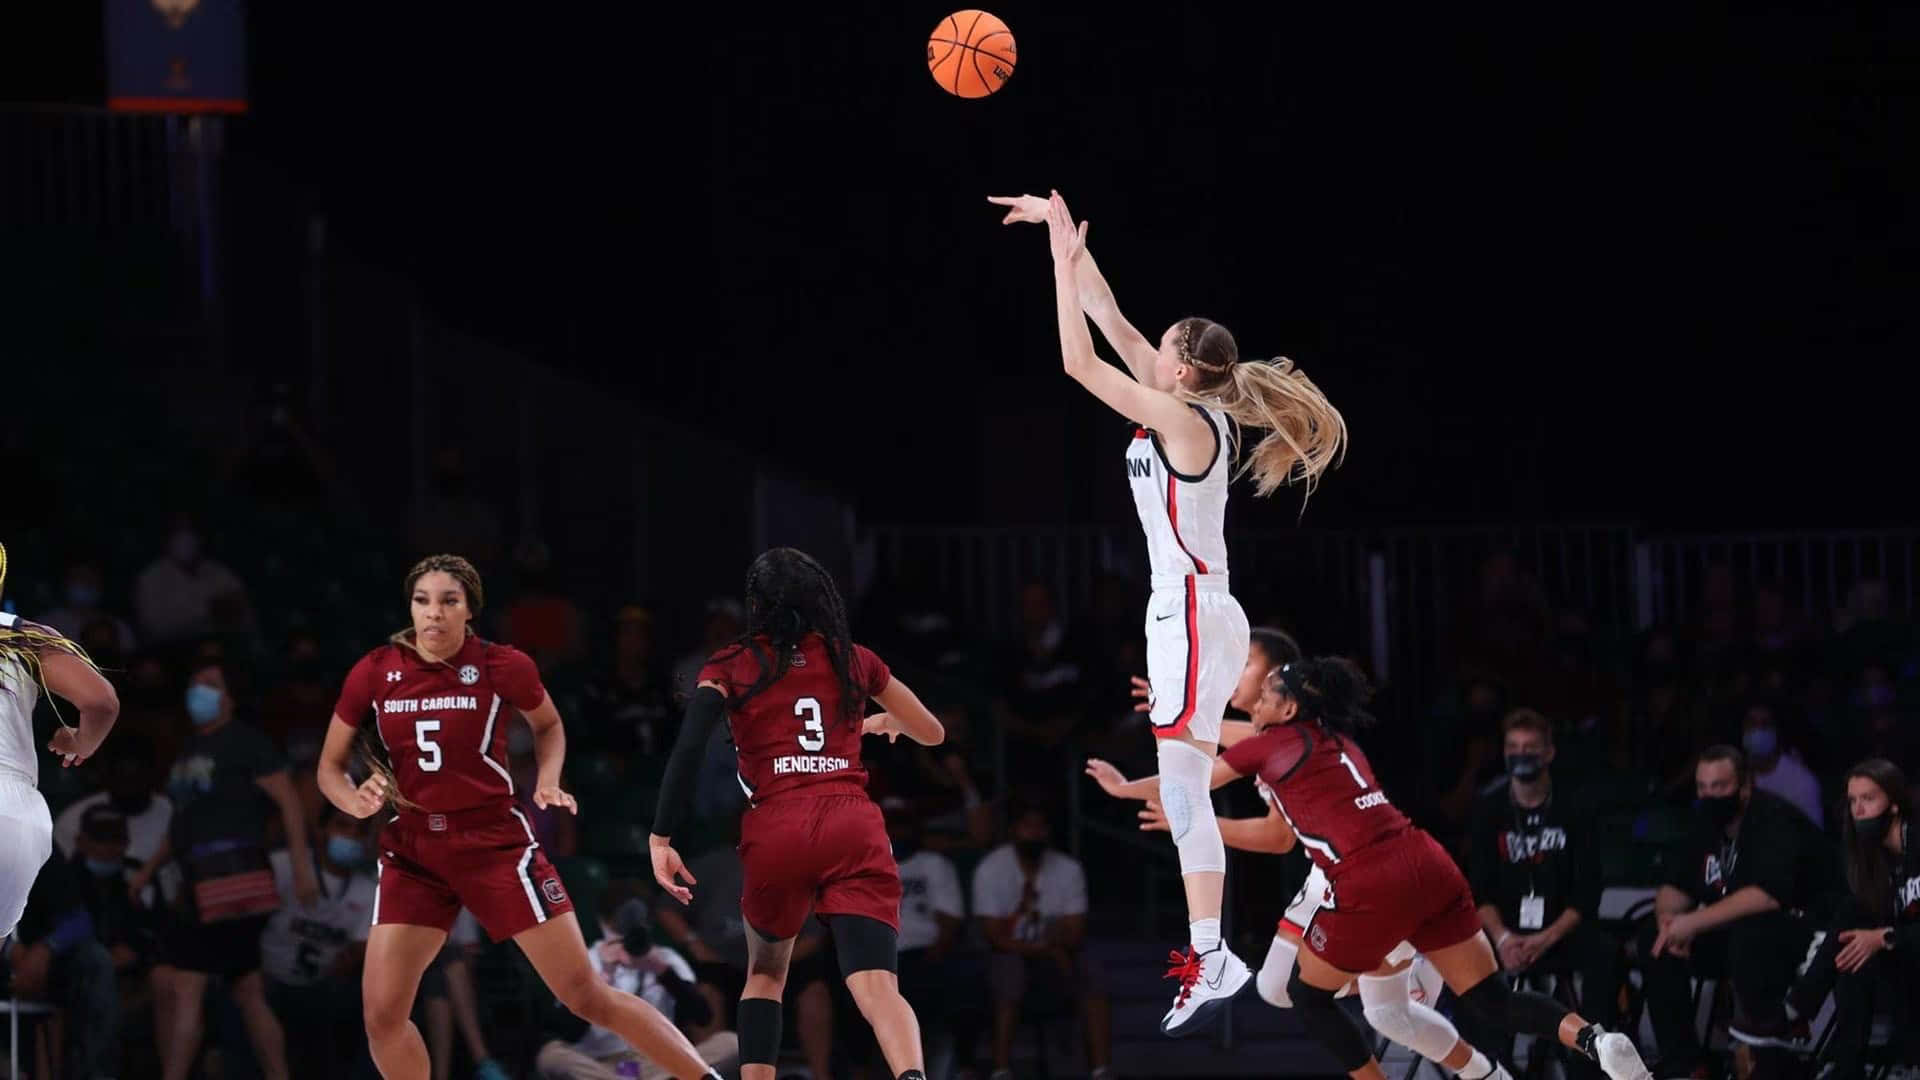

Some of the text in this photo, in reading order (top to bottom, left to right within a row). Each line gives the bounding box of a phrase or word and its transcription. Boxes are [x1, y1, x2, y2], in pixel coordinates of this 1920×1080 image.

[384, 696, 477, 713] SOUTH CAROLINA
[795, 697, 825, 751] 3
[415, 720, 442, 772] 5
[774, 755, 849, 775] HENDERSON
[1340, 752, 1368, 789] 1
